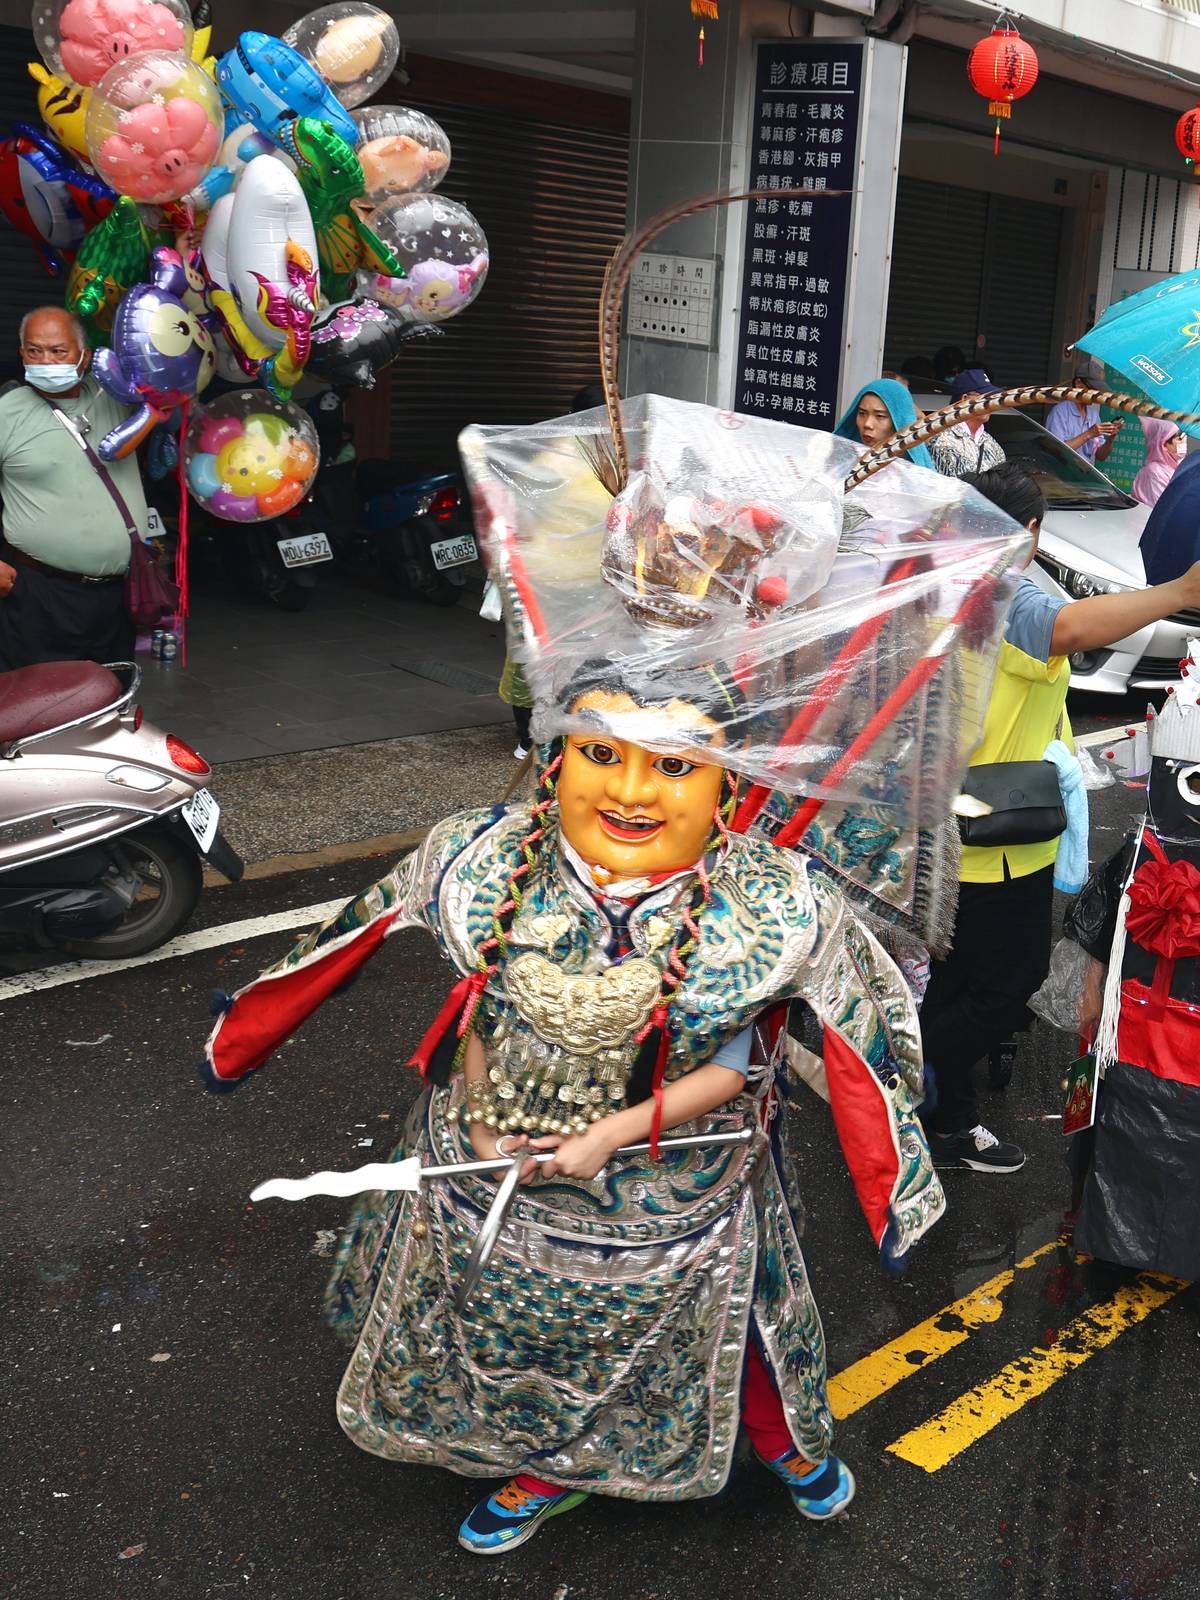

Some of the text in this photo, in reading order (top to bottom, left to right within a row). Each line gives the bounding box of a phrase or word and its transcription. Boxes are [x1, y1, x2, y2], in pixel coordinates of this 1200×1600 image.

[770, 61, 849, 86] 診療項目
[747, 319, 821, 343] 脂漏性皮膚炎
[745, 344, 819, 367] 異位性皮膚炎
[743, 367, 817, 391] 蜂窩性組織炎
[1137, 358, 1166, 381] watsons
[281, 540, 329, 561] MDU-6392
[434, 541, 475, 563] MRC-0835
